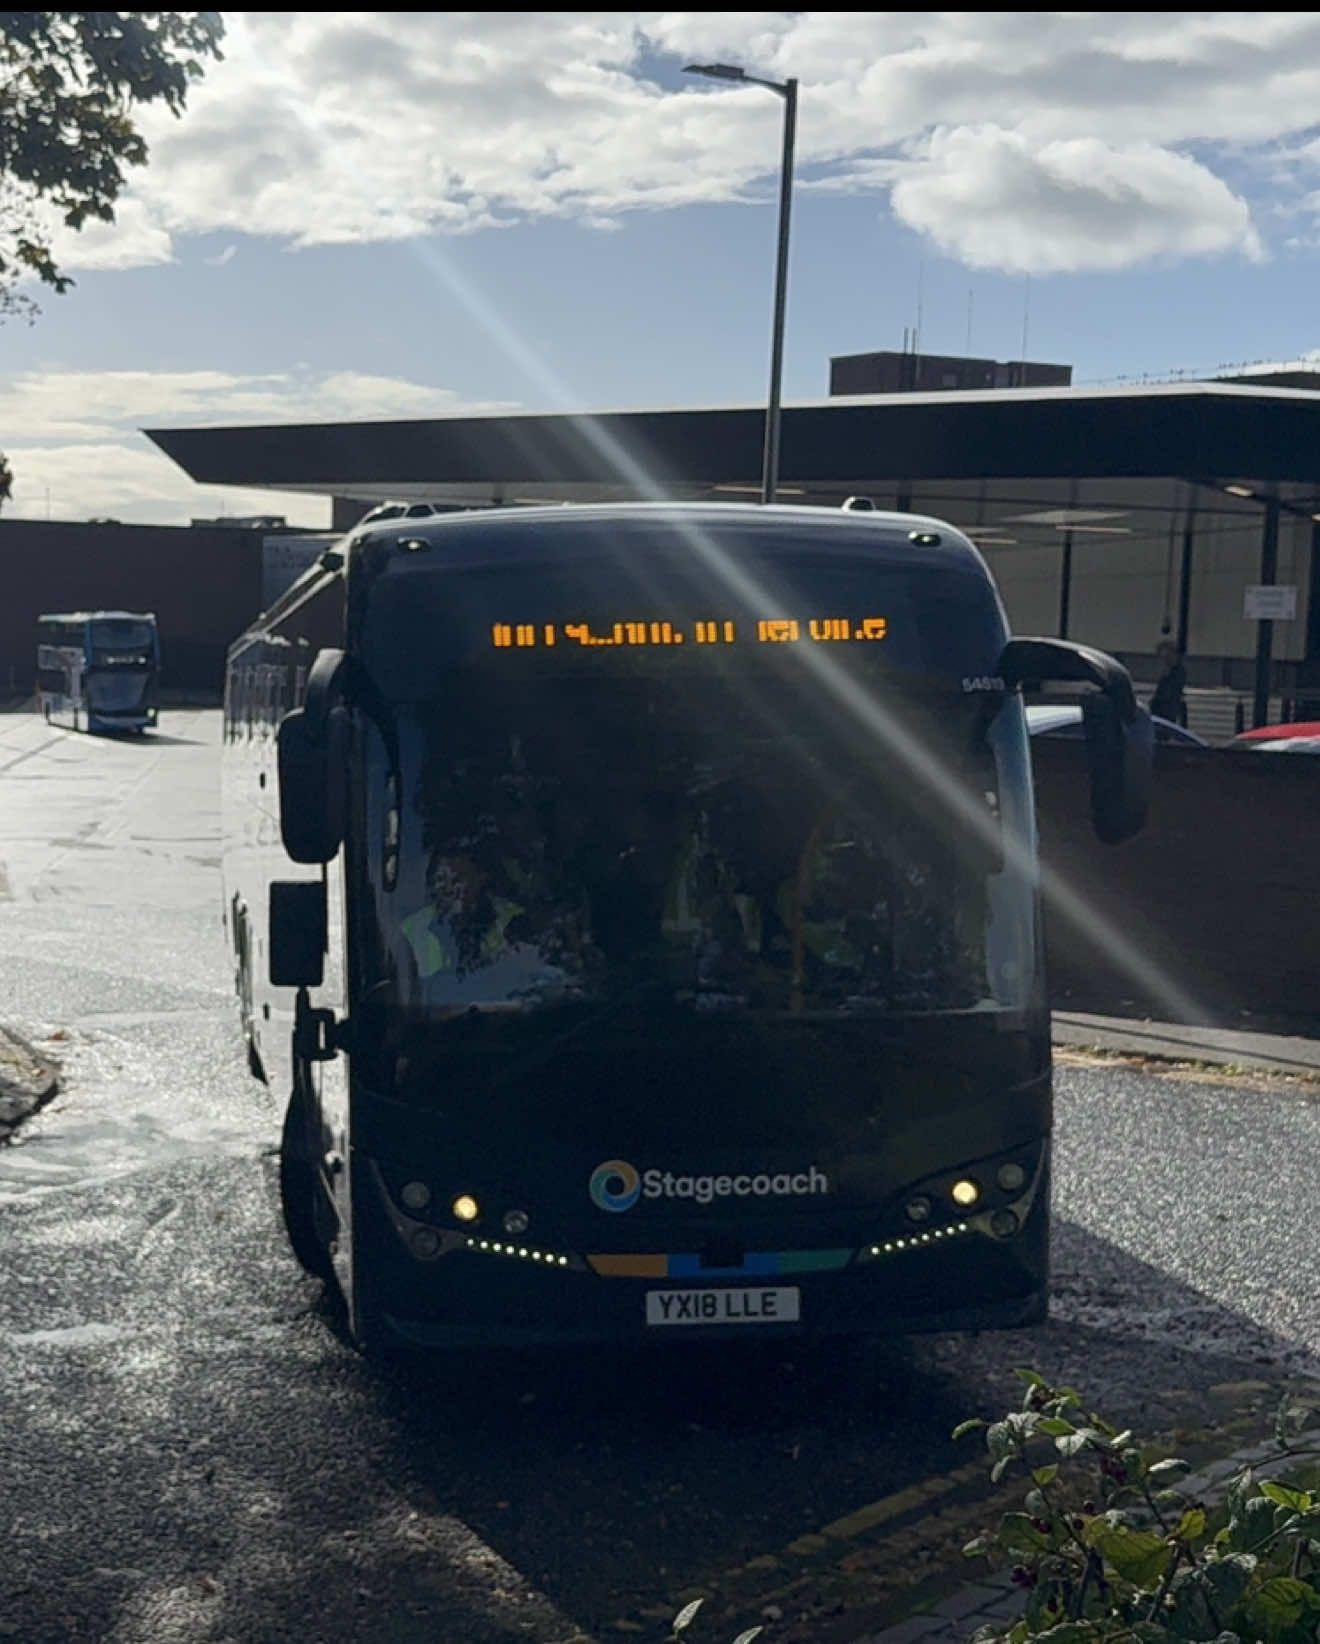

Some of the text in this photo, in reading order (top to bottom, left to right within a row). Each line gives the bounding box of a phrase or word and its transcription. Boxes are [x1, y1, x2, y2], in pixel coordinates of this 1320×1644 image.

[643, 1166, 828, 1203] Stagecoach
[658, 1291, 778, 1320] YX18 LLE
